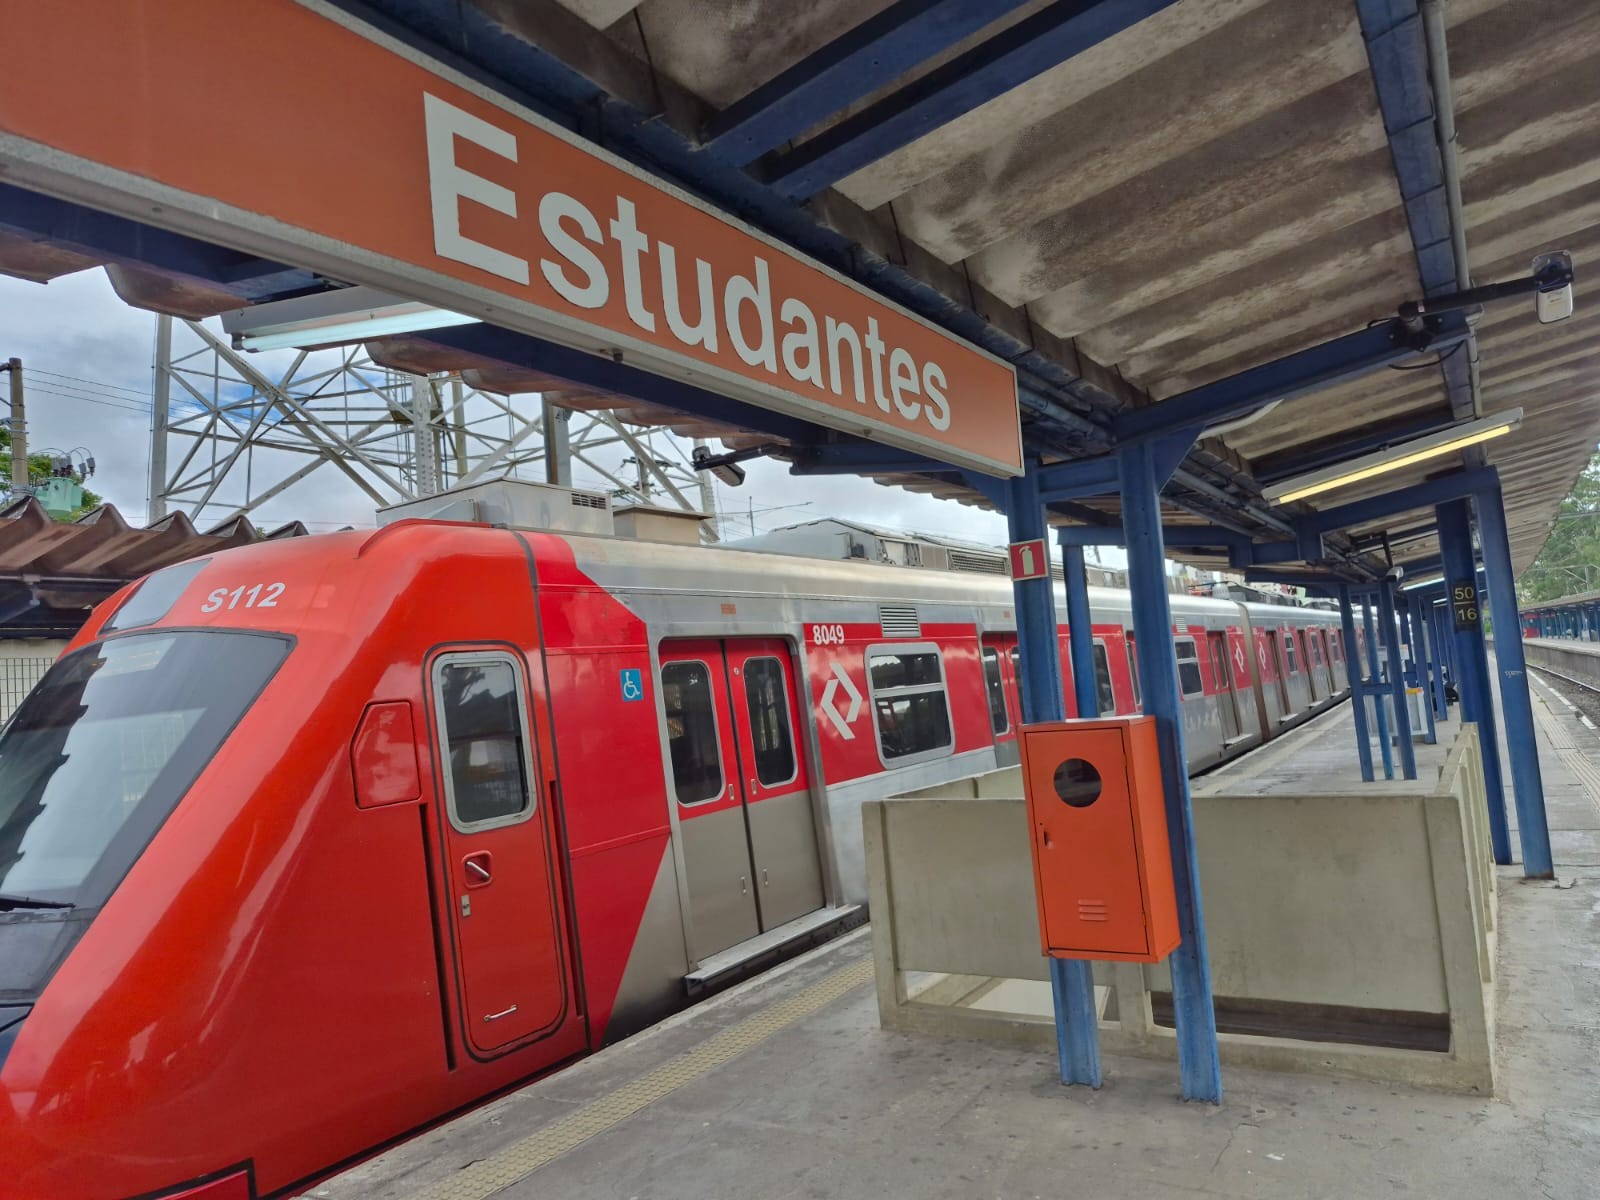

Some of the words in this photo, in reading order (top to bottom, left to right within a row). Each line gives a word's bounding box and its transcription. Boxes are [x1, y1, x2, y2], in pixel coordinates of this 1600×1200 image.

[423, 91, 951, 431] Estudantes
[201, 582, 286, 613] S112
[1454, 587, 1474, 600] 50
[1458, 608, 1478, 621] 16
[812, 624, 845, 645] 8049
